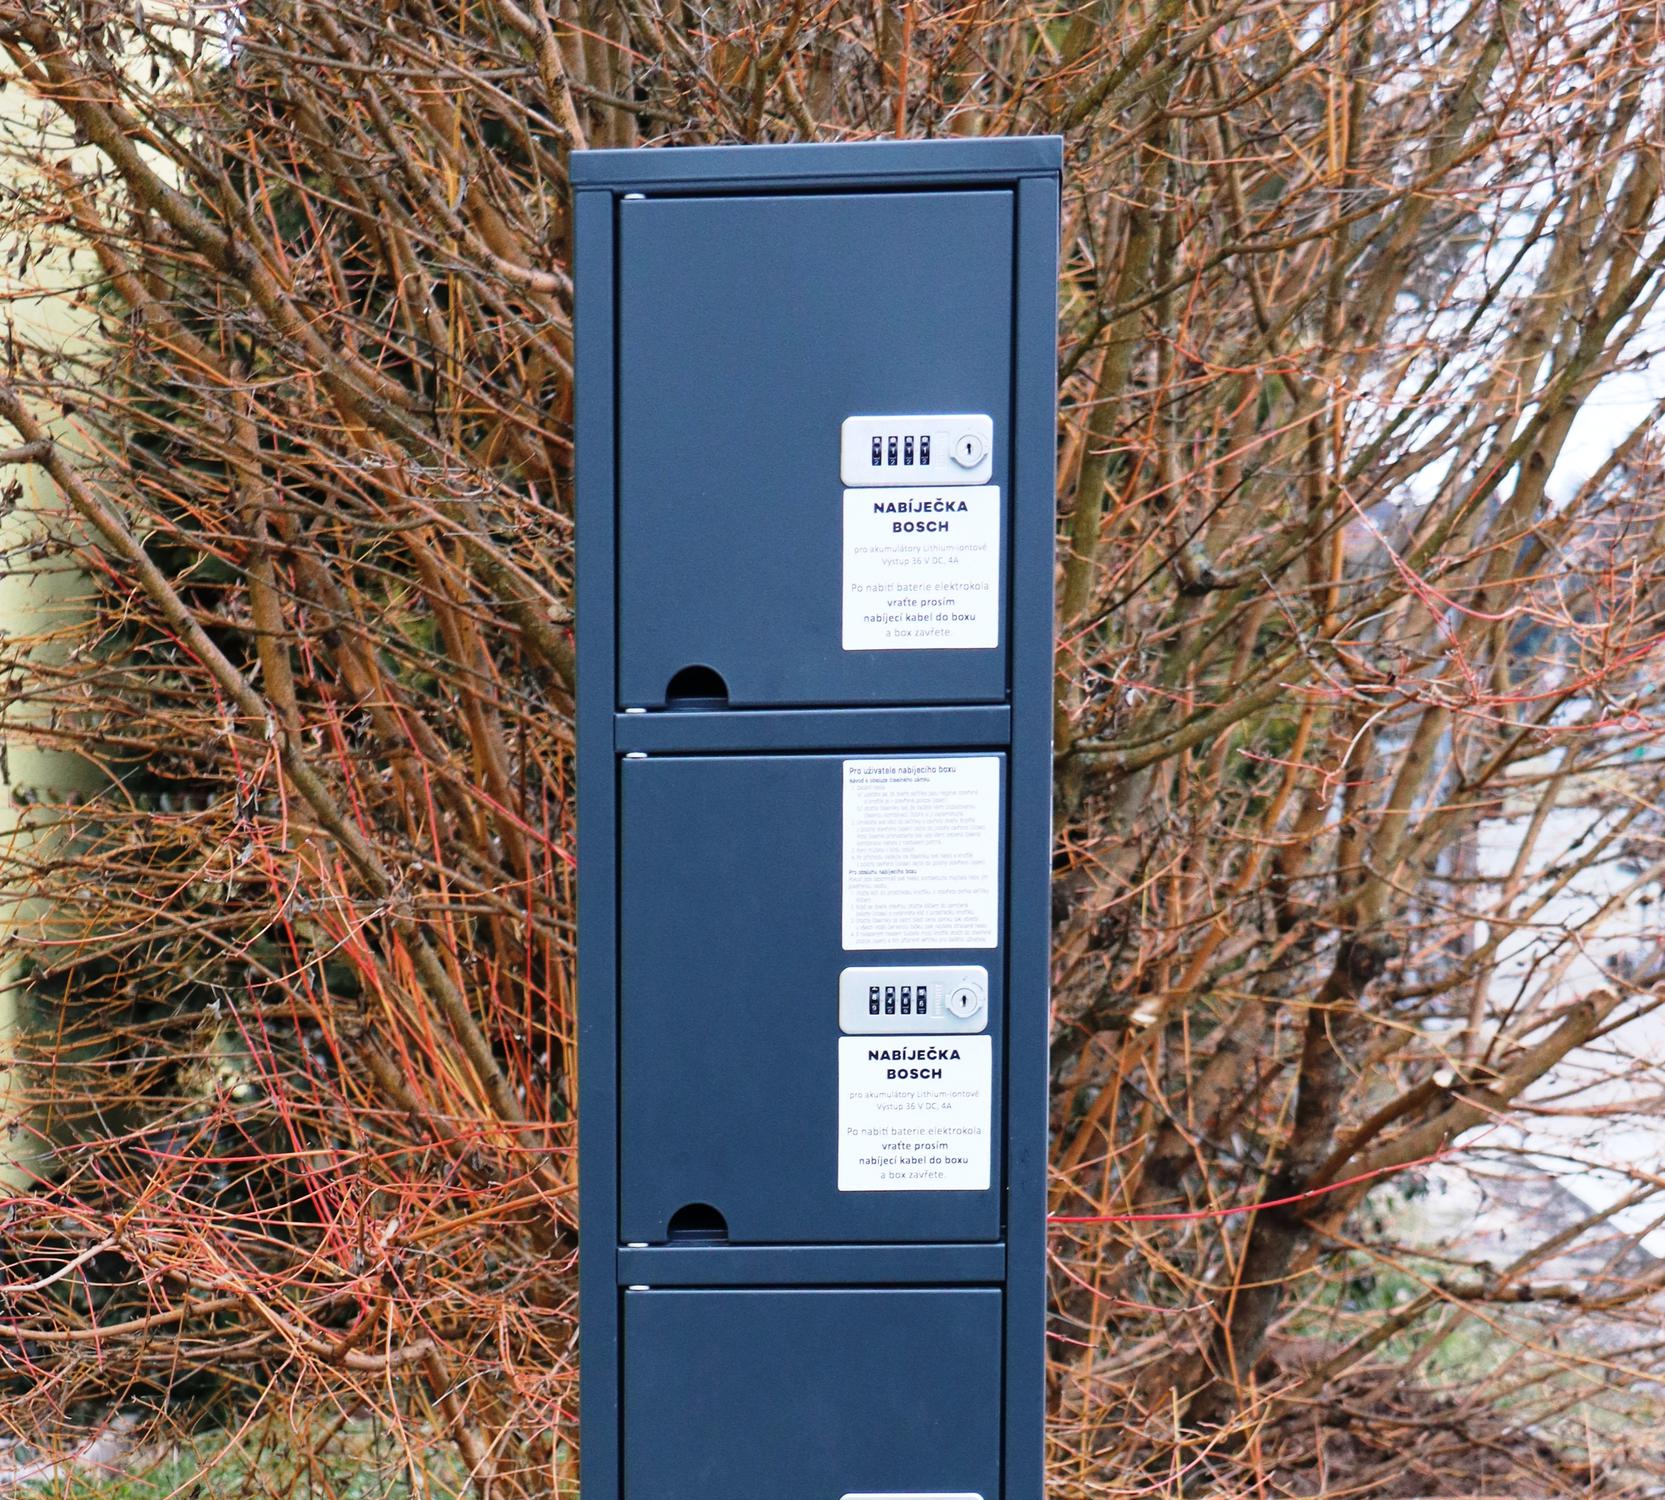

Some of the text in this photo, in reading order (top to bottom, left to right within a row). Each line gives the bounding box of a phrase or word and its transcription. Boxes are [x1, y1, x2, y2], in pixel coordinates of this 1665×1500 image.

[874, 497, 969, 514] NABÍJEČKA
[892, 521, 949, 534] BOSCH
[854, 546, 867, 554] pro
[870, 544, 920, 553] akumulátory
[912, 557, 921, 565] 36
[851, 582, 989, 592] Po nabití baterie elektrokola
[887, 597, 955, 608] vraťte prosím
[864, 613, 976, 624] nabíjecí kabel do boxu
[895, 629, 912, 637] box
[868, 1046, 961, 1061] NABÍJEČKA
[887, 1068, 942, 1079] BOSCH
[862, 1127, 888, 1135] nabití
[891, 1127, 925, 1135] baterie
[928, 1127, 981, 1135] elektrokola
[882, 1141, 948, 1151] vraťte prosím
[859, 1156, 968, 1167] nabíjecí kabel do boxu
